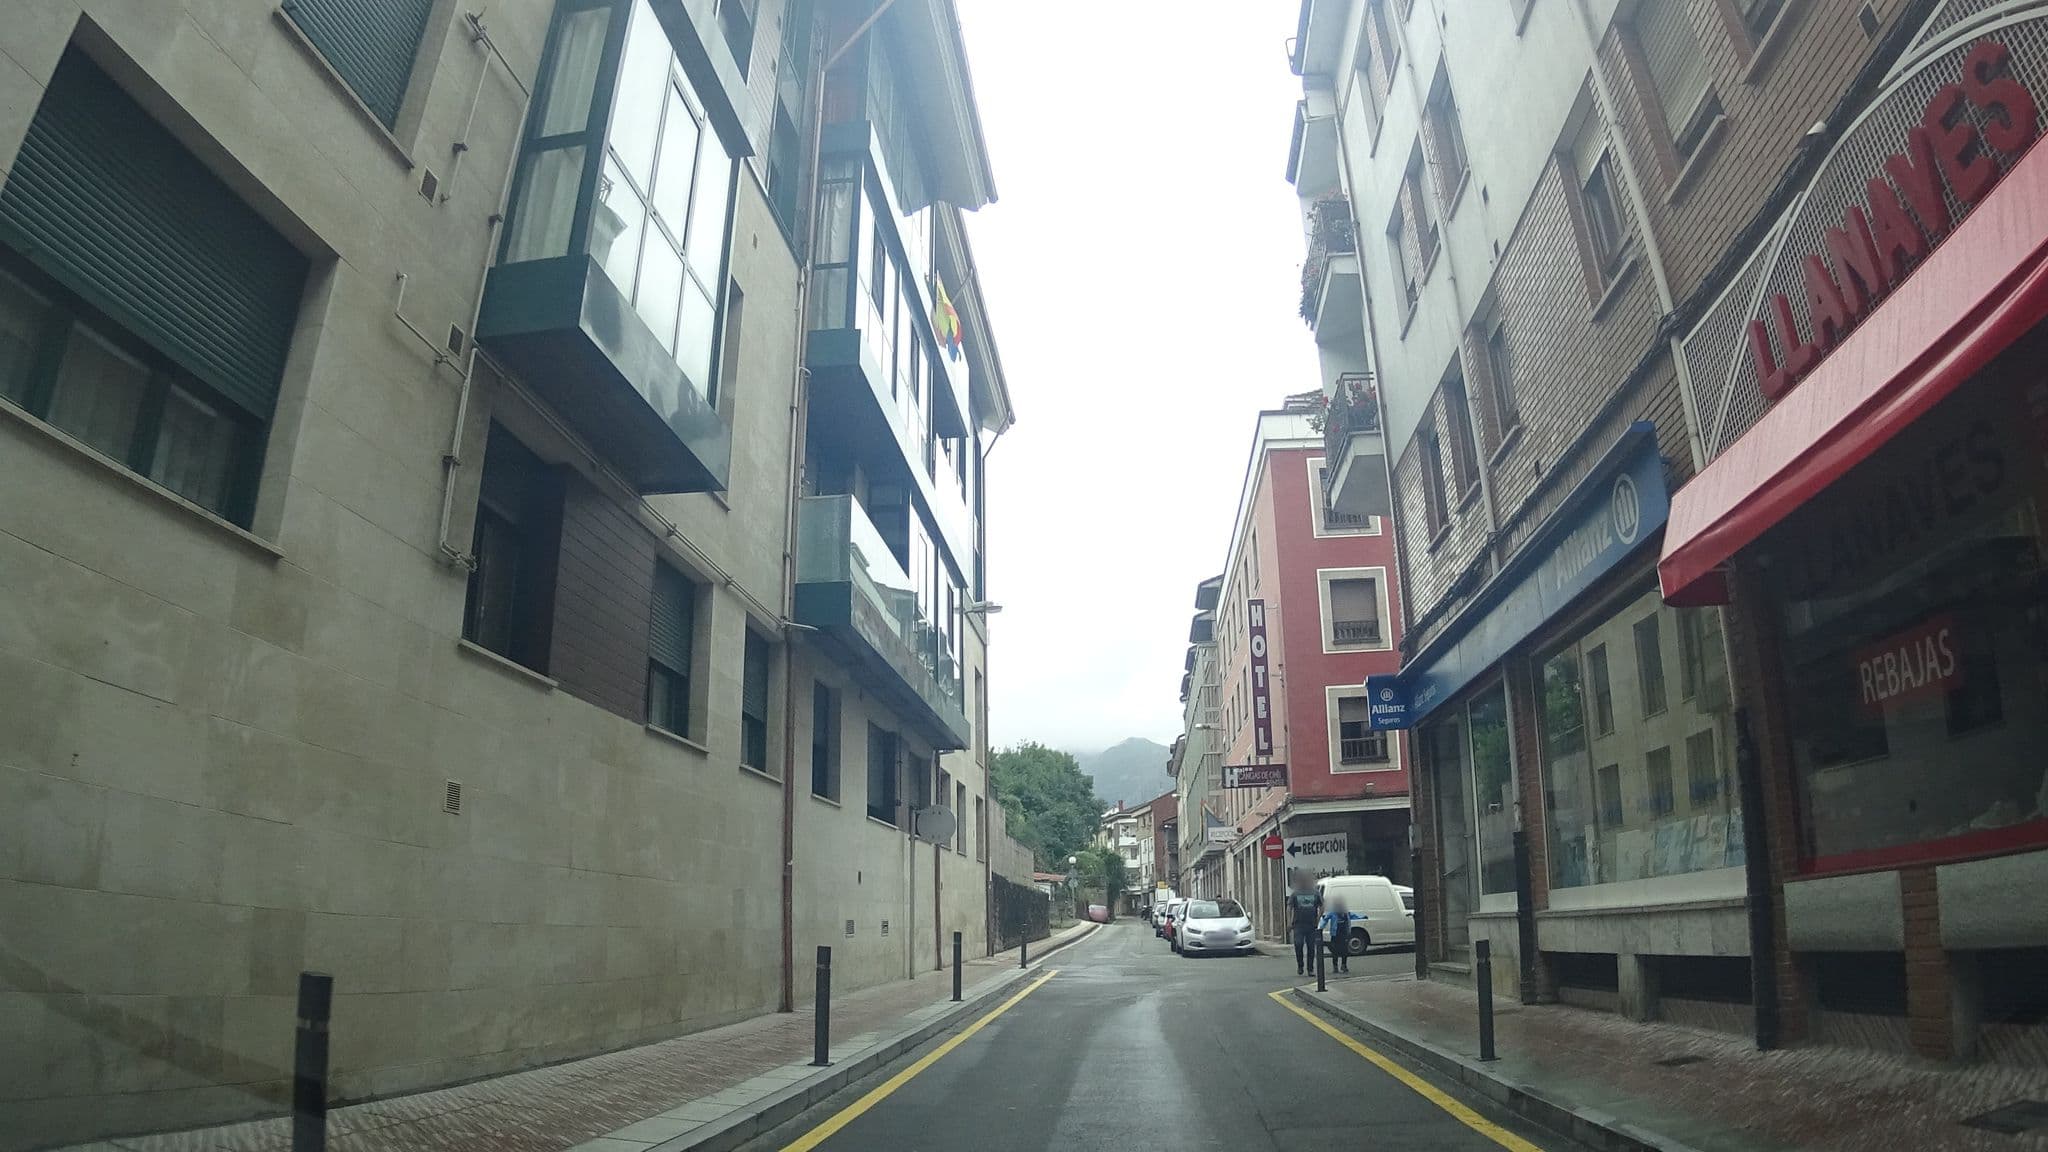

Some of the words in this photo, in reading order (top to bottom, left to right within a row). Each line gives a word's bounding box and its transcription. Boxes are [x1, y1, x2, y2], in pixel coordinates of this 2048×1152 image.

[1748, 41, 2037, 400] LLANAVES
[1554, 512, 1613, 591] Allianz
[1251, 605, 1269, 749] HOTEL
[1860, 629, 1954, 704] REBAJAS
[1372, 704, 1405, 714] Allianz
[1378, 716, 1401, 725] Seguros
[1302, 838, 1346, 856] RECEPCIÓN
